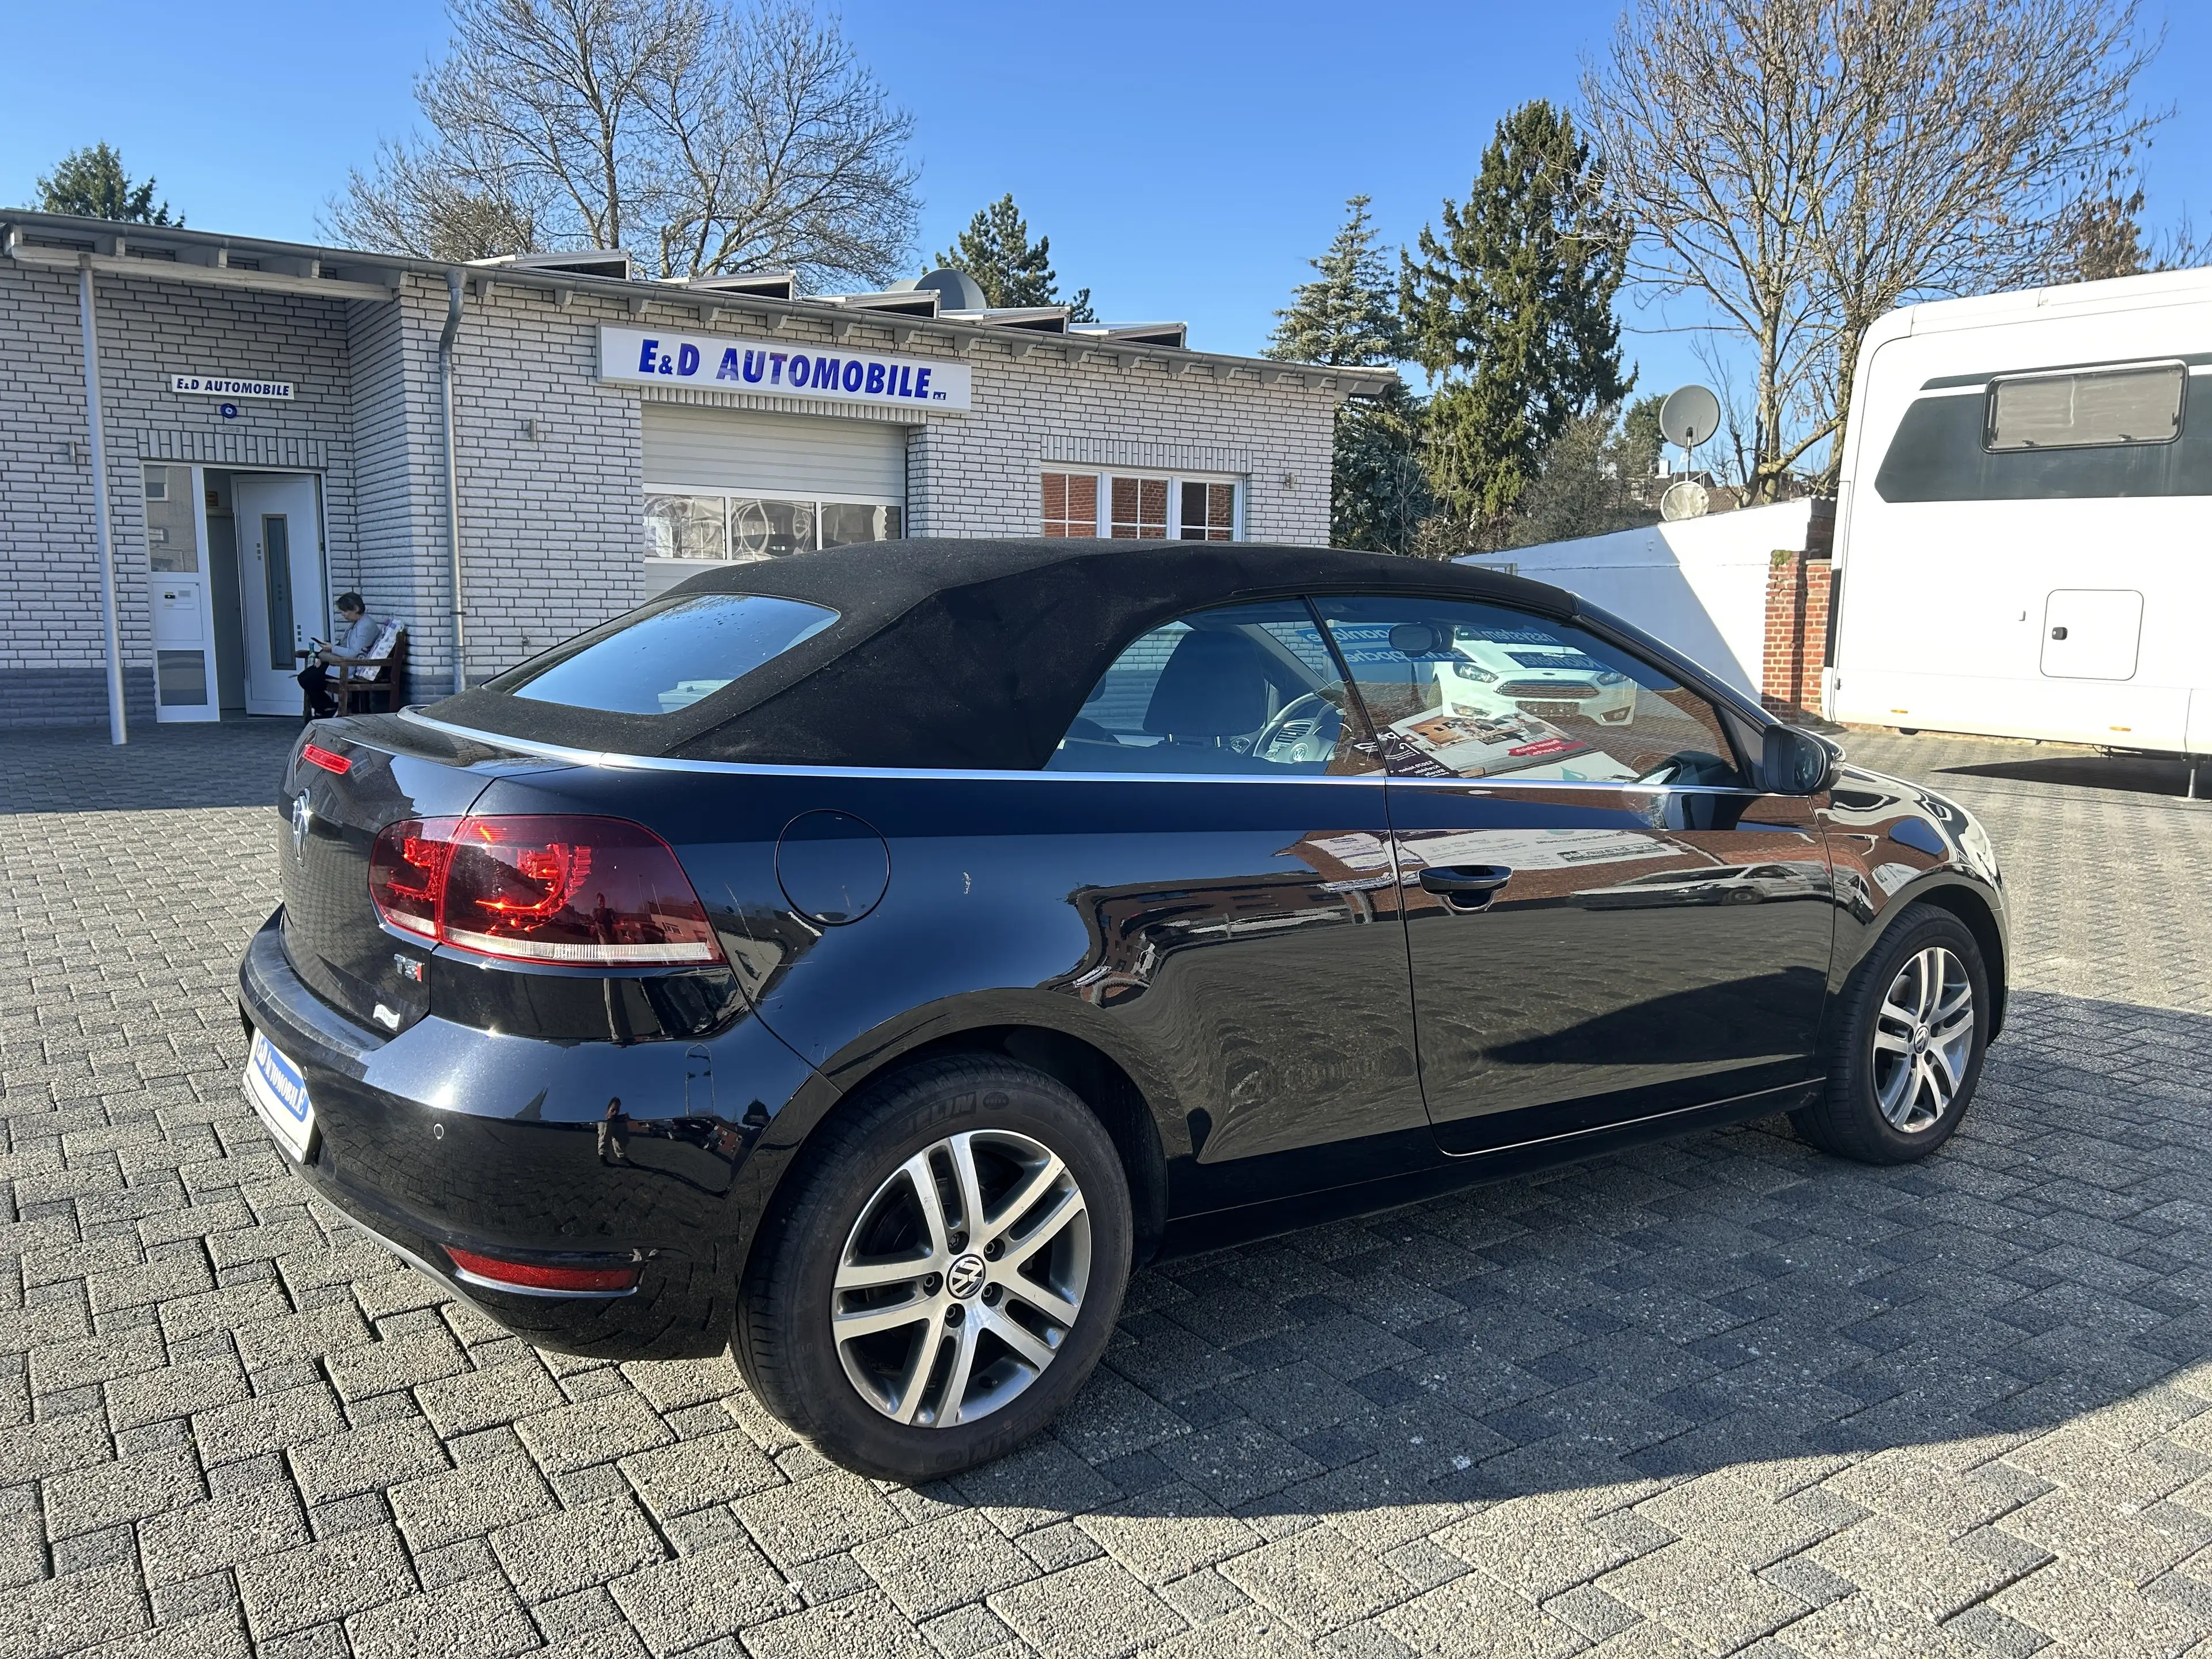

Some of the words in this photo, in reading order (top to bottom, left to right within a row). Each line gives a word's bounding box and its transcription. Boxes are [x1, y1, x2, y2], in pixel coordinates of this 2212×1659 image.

[177, 378, 199, 390] E&D
[204, 380, 290, 396] AUTOMOBILE
[638, 339, 700, 376] E&D
[715, 347, 931, 399] AUTOMOBILE
